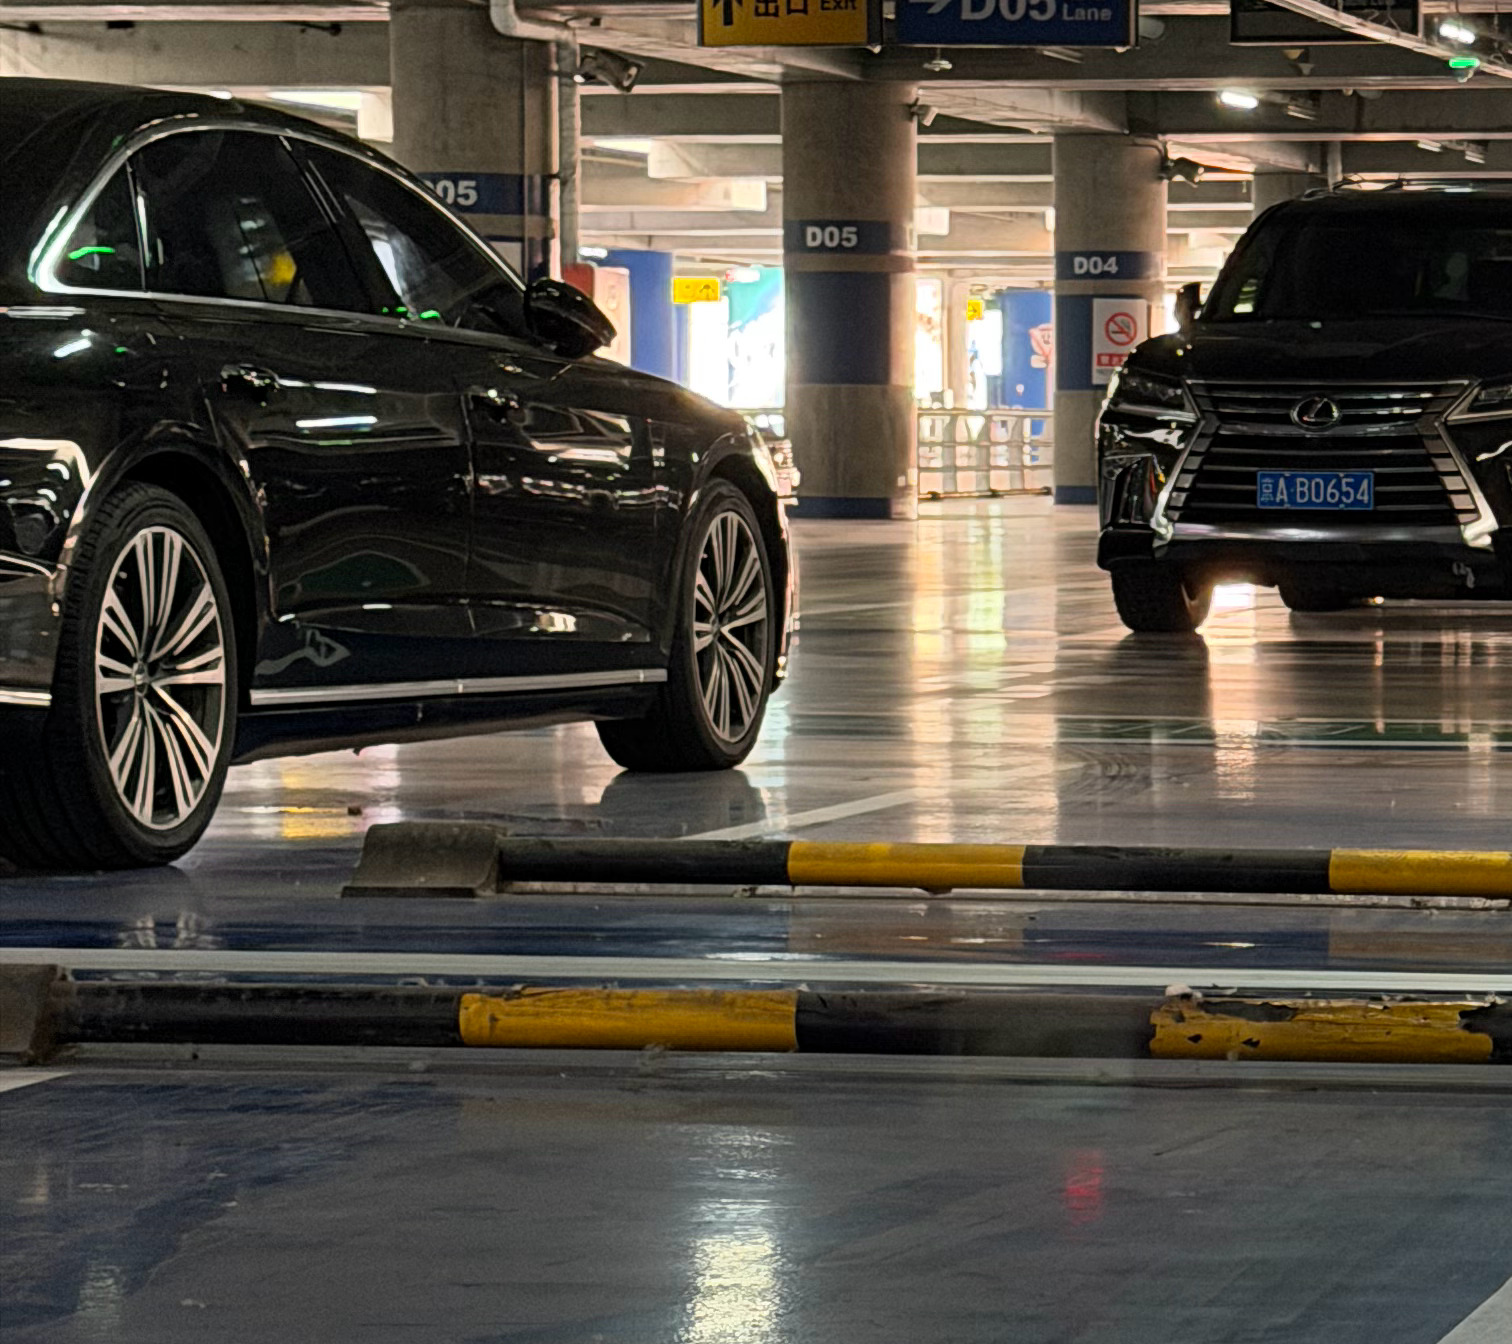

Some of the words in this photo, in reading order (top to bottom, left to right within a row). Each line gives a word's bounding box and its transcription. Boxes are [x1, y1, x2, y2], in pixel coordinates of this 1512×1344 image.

[1062, 2, 1112, 21] Lane
[423, 179, 478, 207] 05
[805, 226, 858, 248] D05
[1073, 256, 1119, 276] D04
